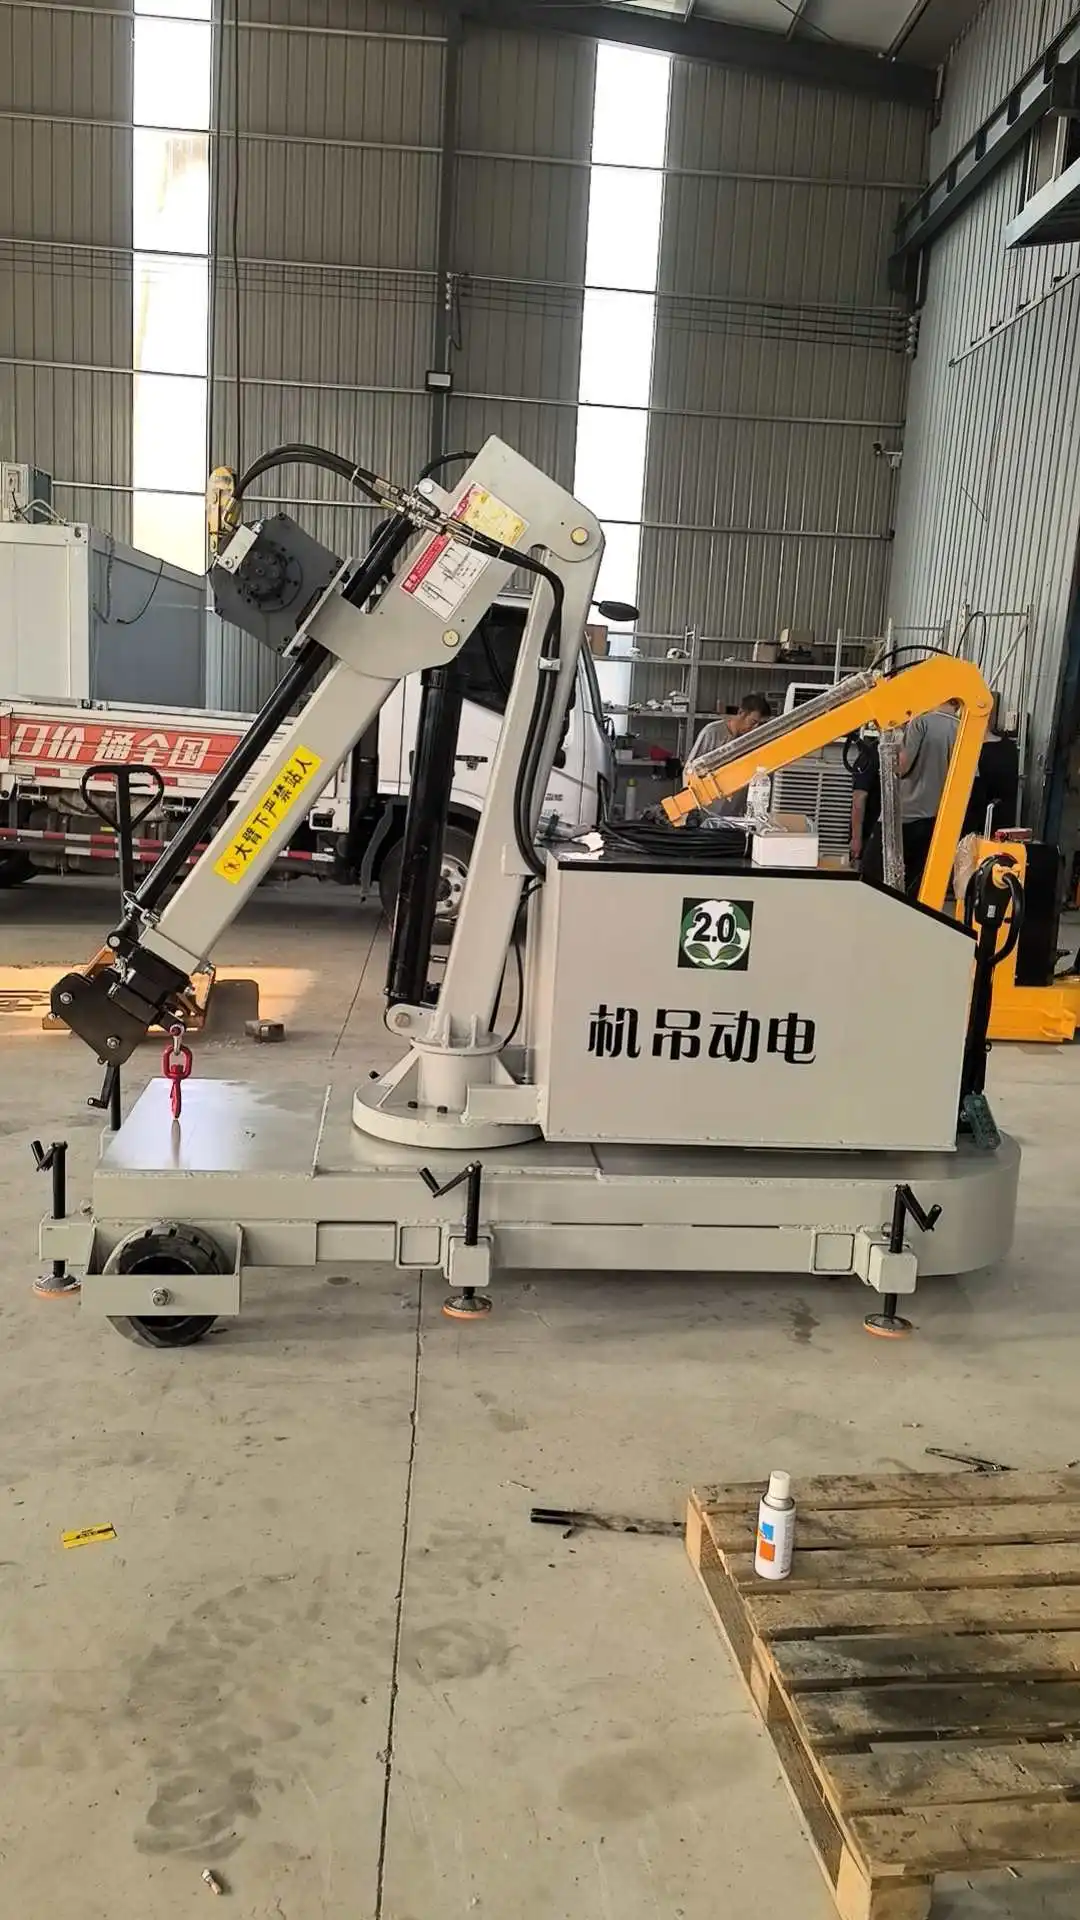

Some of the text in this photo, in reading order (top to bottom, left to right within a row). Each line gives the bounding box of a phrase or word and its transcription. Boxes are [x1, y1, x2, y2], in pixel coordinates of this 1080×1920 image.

[94, 730, 211, 769] 通全国
[234, 757, 313, 861] 大臂下严禁站人
[692, 911, 736, 944] 2.0
